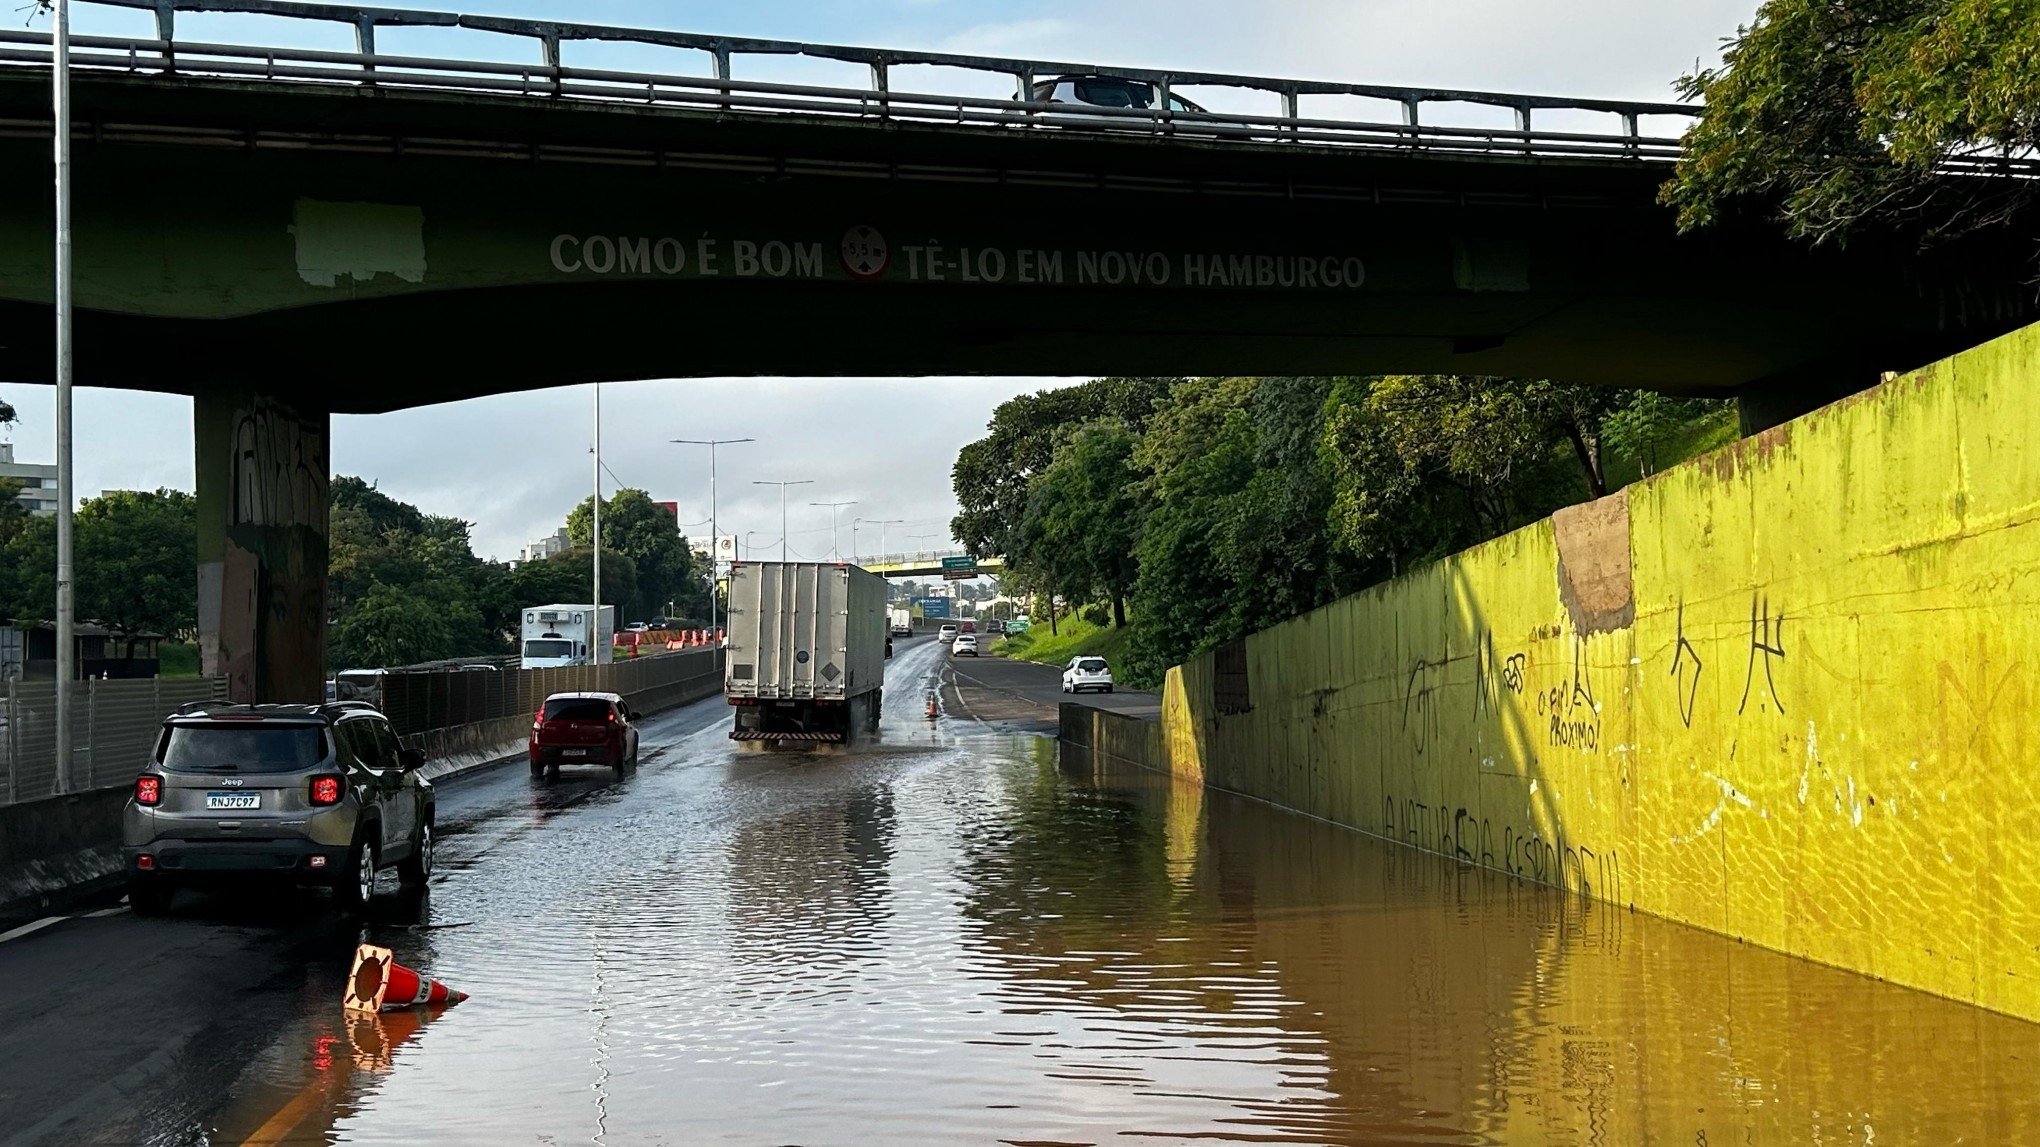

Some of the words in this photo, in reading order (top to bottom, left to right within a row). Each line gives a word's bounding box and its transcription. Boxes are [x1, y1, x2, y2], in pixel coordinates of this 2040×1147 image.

[549, 234, 686, 275] COMO
[698, 231, 719, 275] É
[733, 239, 824, 277] BOM
[849, 242, 869, 259] 5,5
[902, 238, 1006, 282] TÊ-LO
[1017, 249, 1063, 283] EM
[1077, 250, 1171, 286] NOVO
[1184, 253, 1366, 288] HAMBURGO
[221, 778, 244, 787] Jeep
[211, 797, 255, 808] RNJ7C97
